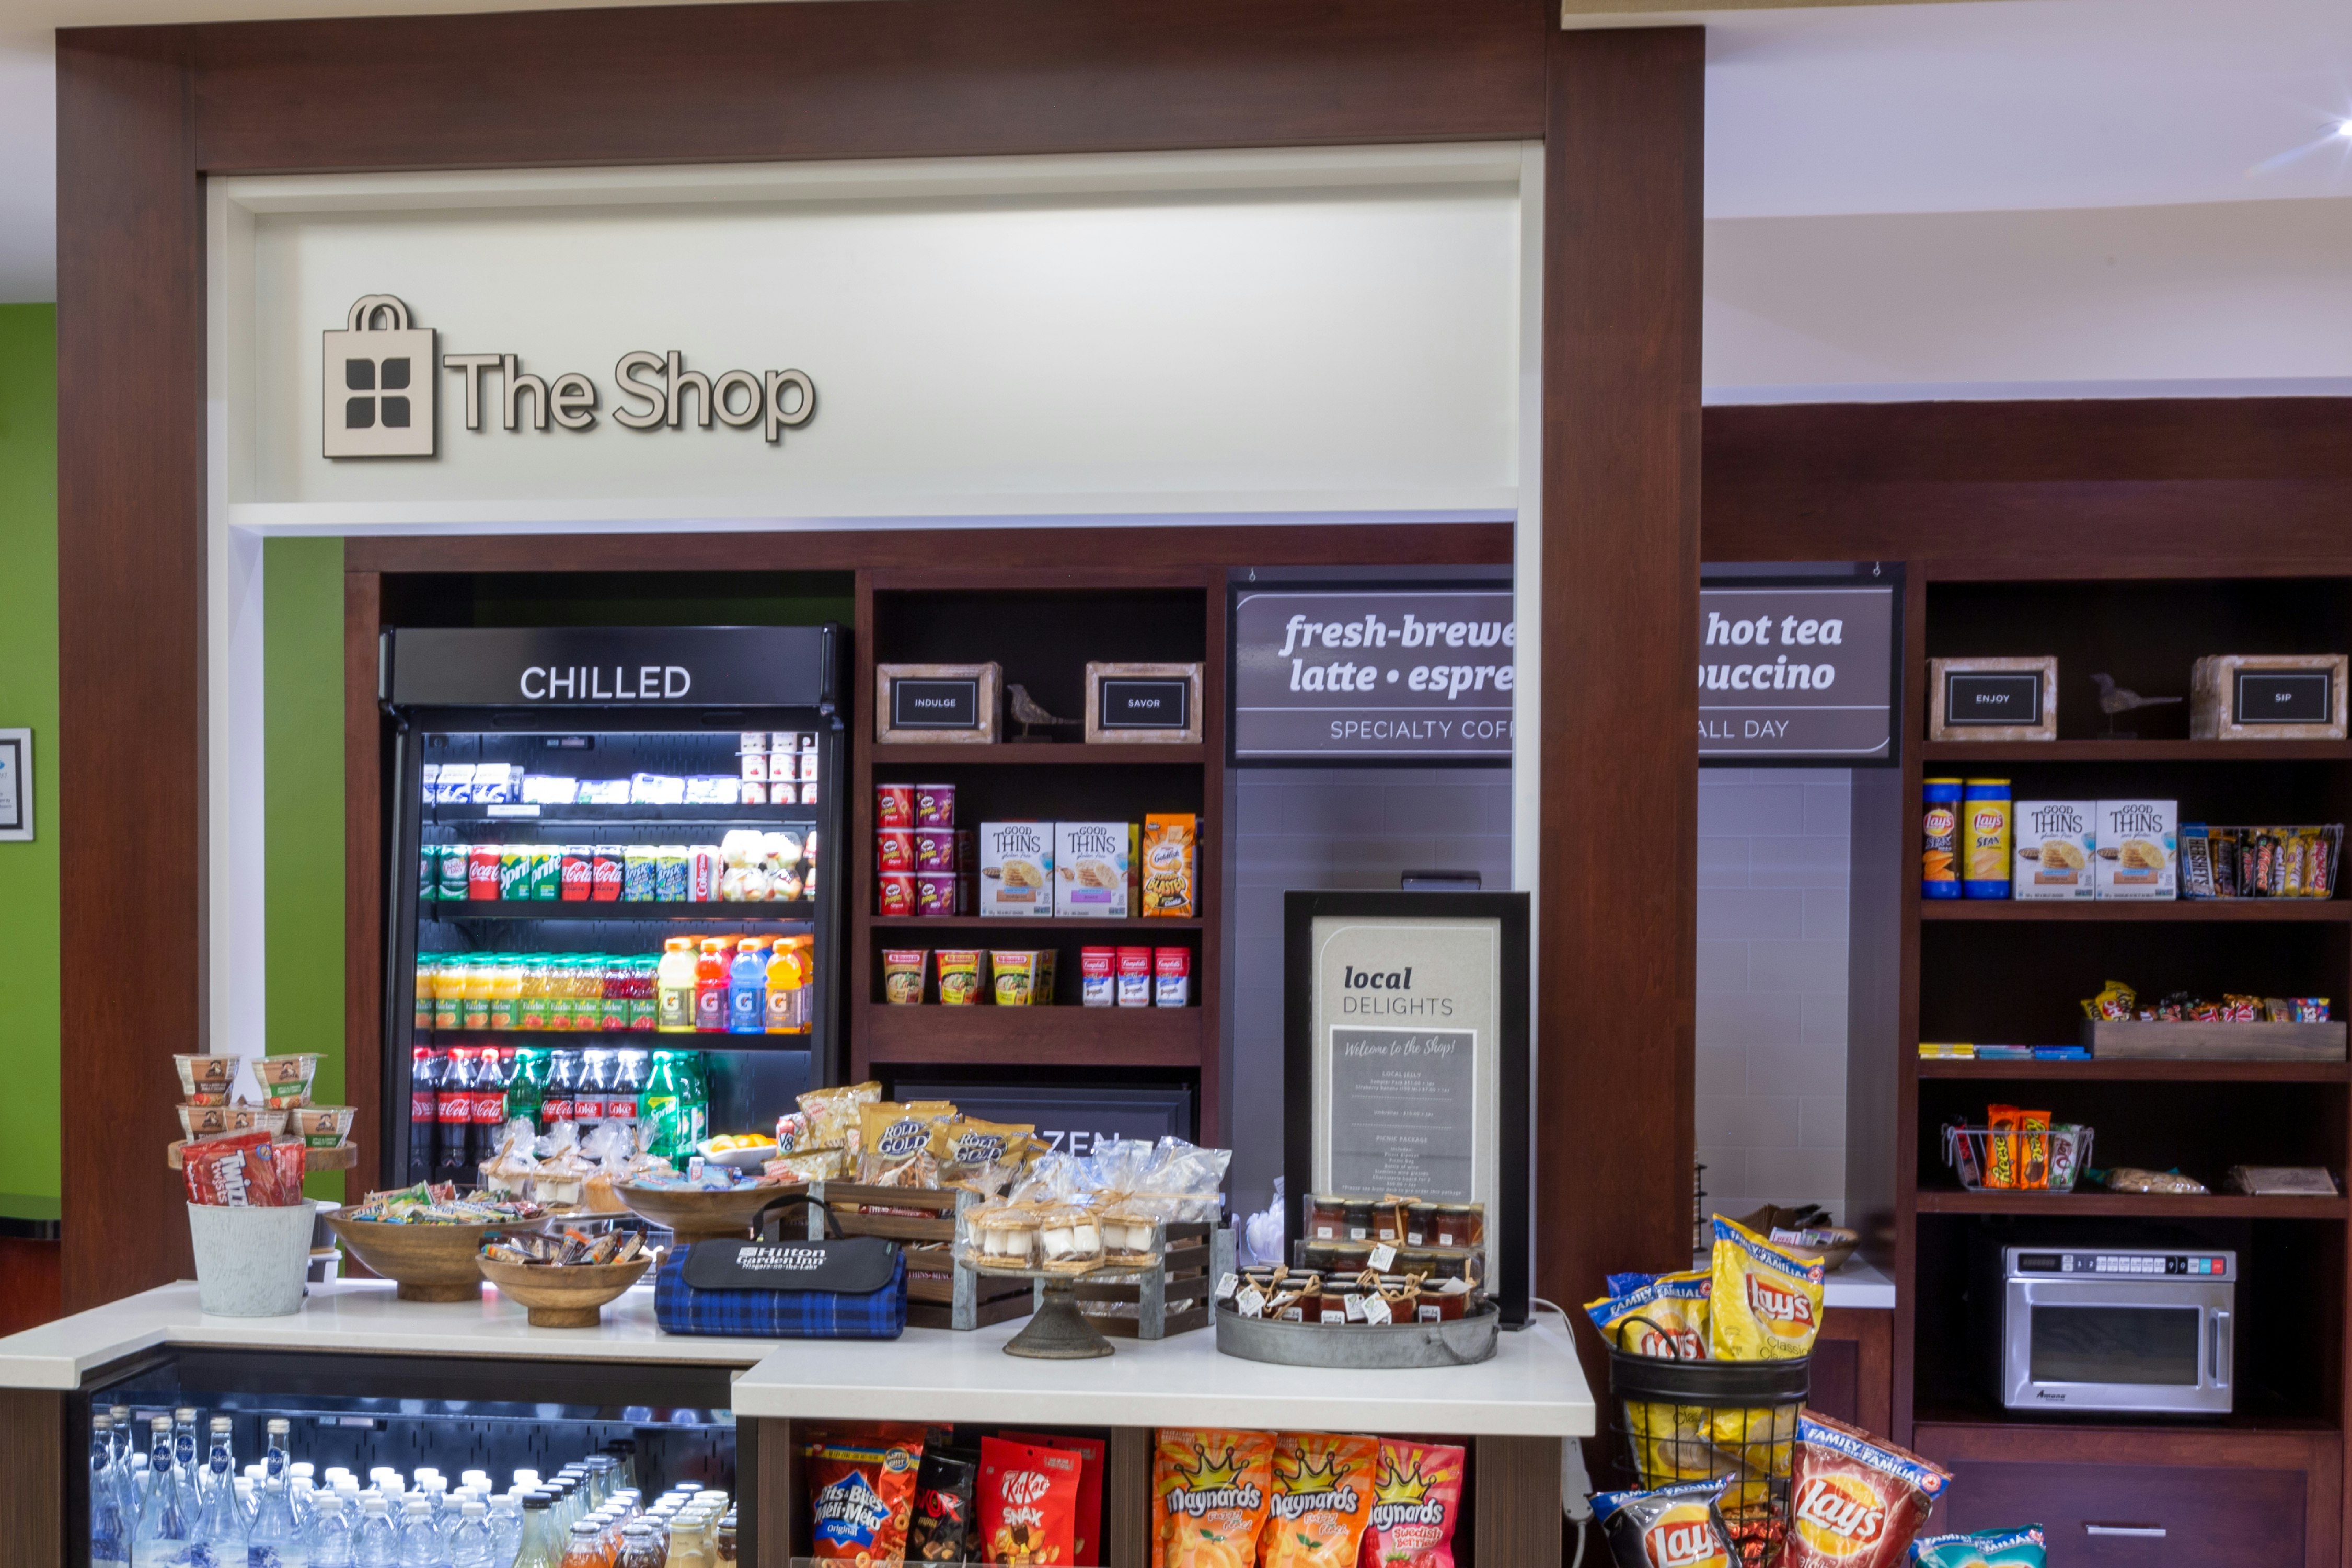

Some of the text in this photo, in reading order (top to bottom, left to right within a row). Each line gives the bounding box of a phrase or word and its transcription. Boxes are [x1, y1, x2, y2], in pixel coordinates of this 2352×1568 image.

[443, 349, 817, 444] The Shop
[1705, 612, 1772, 646] hot
[1780, 615, 1843, 646] tea
[520, 666, 691, 699] CHILLED
[1290, 659, 1378, 692] latte
[915, 698, 956, 708] INDULGE
[1127, 699, 1160, 708] SAVOR
[1976, 694, 2010, 705] ENJOY
[2275, 693, 2292, 703] SIP
[1330, 720, 1453, 740] SPECIALTY
[1745, 720, 1789, 739] DAY
[2043, 805, 2073, 814] GOOD
[2123, 804, 2153, 814] GOOD
[1004, 826, 1032, 835] GOOD
[1079, 826, 1108, 836] GOOD
[2031, 811, 2083, 834] THINS
[2110, 810, 2163, 833] THINS
[993, 831, 1041, 854] THINS
[1068, 832, 1116, 854] THINS
[1344, 966, 1412, 990] local
[1344, 996, 1453, 1017] DELIGHTS
[1345, 1035, 1456, 1059] Welcome to the Shop!
[779, 1131, 794, 1151] V8
[884, 1124, 919, 1138] ROLD
[960, 1133, 997, 1149] ROLD
[878, 1135, 928, 1154] GOLD
[954, 1146, 1003, 1163] GOLD
[737, 1256, 825, 1265] Garden Inn
[758, 1247, 826, 1258] Hilton
[1610, 1288, 1652, 1316] FAMILY
[1751, 1276, 1810, 1321] Lay's
[1808, 1428, 1862, 1451] FAMILY
[1862, 1451, 1921, 1485] FAMILIAL
[821, 1485, 845, 1503] Bits
[848, 1484, 883, 1513] Bites
[1167, 1482, 1262, 1517] Maynards
[1796, 1478, 1883, 1537] Lay's
[1002, 1505, 1045, 1528] SNAX
[1207, 1509, 1243, 1521] Fuzzy
[1304, 1512, 1338, 1524] Fuzzy
[1369, 1498, 1444, 1531] aynards
[827, 1524, 858, 1536] Original
[1222, 1519, 1253, 1531] Peach
[1319, 1523, 1349, 1535] Peach
[1392, 1527, 1443, 1540] Swedish
